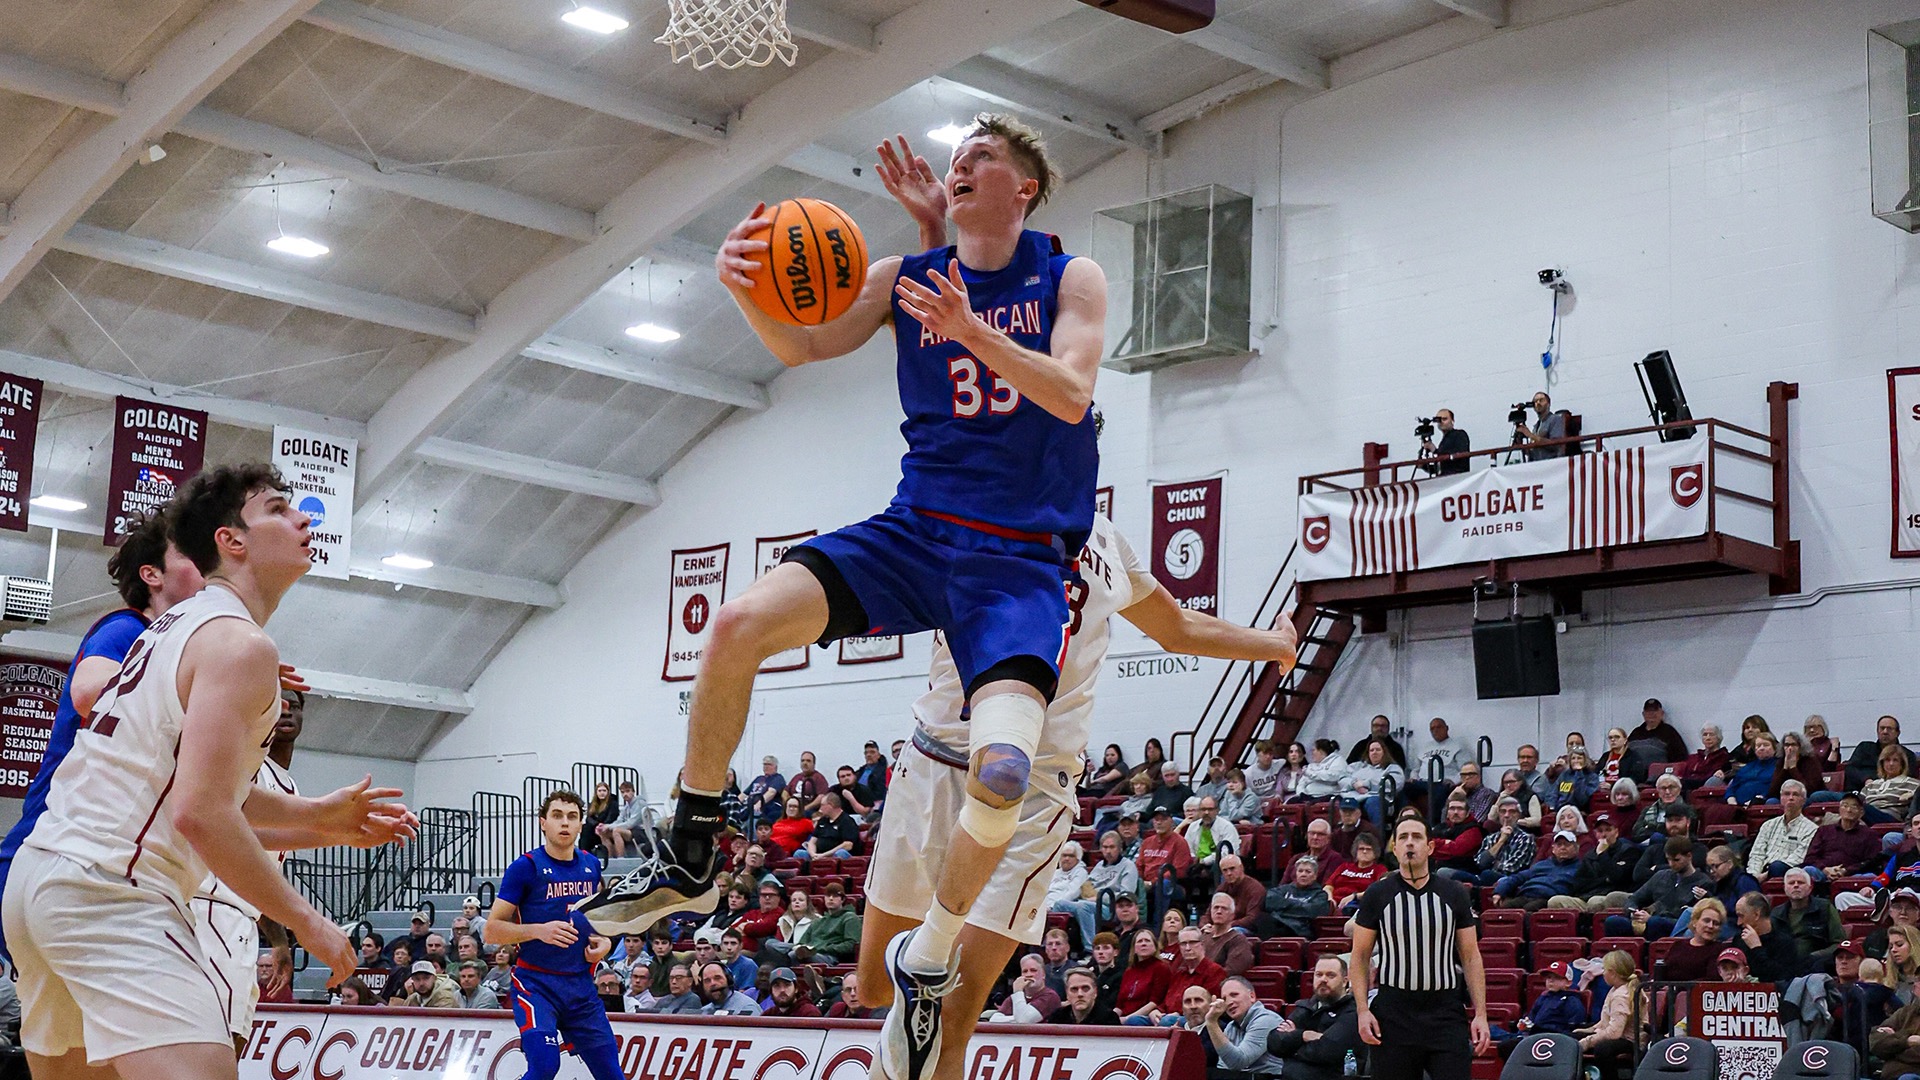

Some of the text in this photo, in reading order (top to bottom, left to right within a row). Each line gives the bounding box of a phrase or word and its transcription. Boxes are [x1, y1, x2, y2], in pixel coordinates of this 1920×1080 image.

[786, 225, 817, 310] Wilson
[825, 228, 851, 289] NCAA
[920, 299, 1042, 348] AICAN
[0, 382, 33, 411] ATE
[123, 409, 199, 441] COLGATE
[137, 431, 183, 447] RAIDERS
[145, 444, 172, 458] MEN'S
[281, 438, 349, 467] COLGATE
[131, 452, 184, 470] BASKETBALL
[293, 460, 335, 474] RAIDERS
[301, 473, 326, 484] MEN'S
[1675, 471, 1698, 496] C
[123, 491, 174, 504] TOURNAM
[289, 481, 336, 496] BASKETBALL
[1167, 487, 1207, 504] VICKY
[1441, 484, 1544, 523] COLGATE
[1167, 506, 1206, 522] CHUN
[310, 531, 343, 545] AMENT
[1305, 521, 1328, 545] C
[1462, 521, 1524, 538] RAIDERS
[309, 547, 329, 565] 24
[1180, 543, 1189, 565] 5
[683, 556, 716, 571] ERNIE
[1080, 544, 1112, 591] ATE
[675, 571, 722, 588] VANDEWEGHE
[1175, 595, 1216, 610] -1991
[690, 604, 703, 625] 11
[1117, 656, 1199, 678] SECTION 2
[17, 698, 44, 709] MEN'S
[2, 706, 56, 721] BASKETBALL
[2, 724, 52, 739] REGULAR
[5, 737, 47, 751] SEASON
[1252, 773, 1278, 787] COLGA
[545, 881, 593, 900] AMERICAN
[357, 974, 389, 989] AMED
[1702, 991, 1781, 1013] GAMEDA
[360, 1027, 492, 1074] COLGATE
[1531, 1039, 1556, 1061] C
[1665, 1042, 1690, 1066] C
[1802, 1045, 1829, 1070] C
[967, 1045, 1080, 1080] GATE
